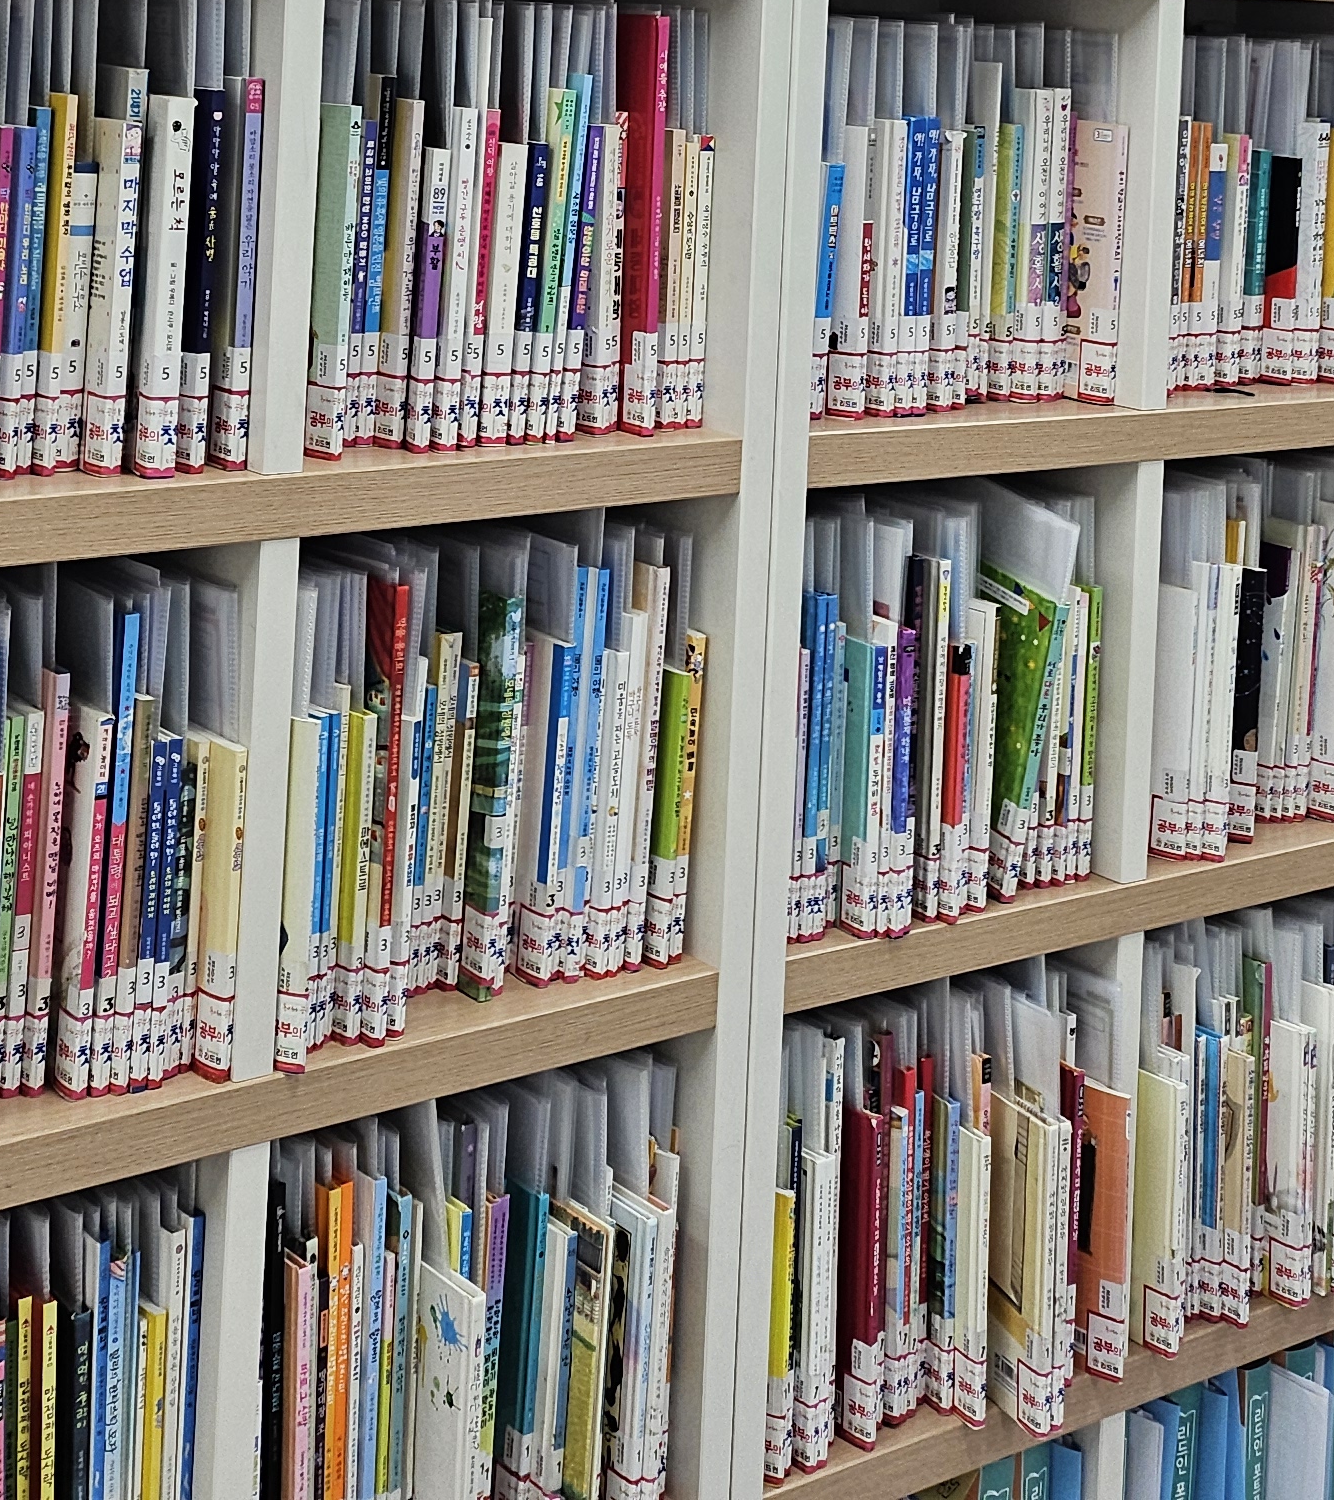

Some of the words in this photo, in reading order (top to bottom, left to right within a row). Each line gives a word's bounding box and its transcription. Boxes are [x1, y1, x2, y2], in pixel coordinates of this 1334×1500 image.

[170, 168, 186, 212] 모르는
[433, 187, 446, 201] 89
[120, 176, 139, 240] 마지막
[168, 217, 185, 232] 척
[119, 245, 135, 288] 수업
[429, 243, 442, 271] 부활
[115, 364, 124, 379] 5
[833, 374, 859, 391] 공부의
[107, 892, 121, 920] 되고
[1250, 1407, 1264, 1459] 리드인
